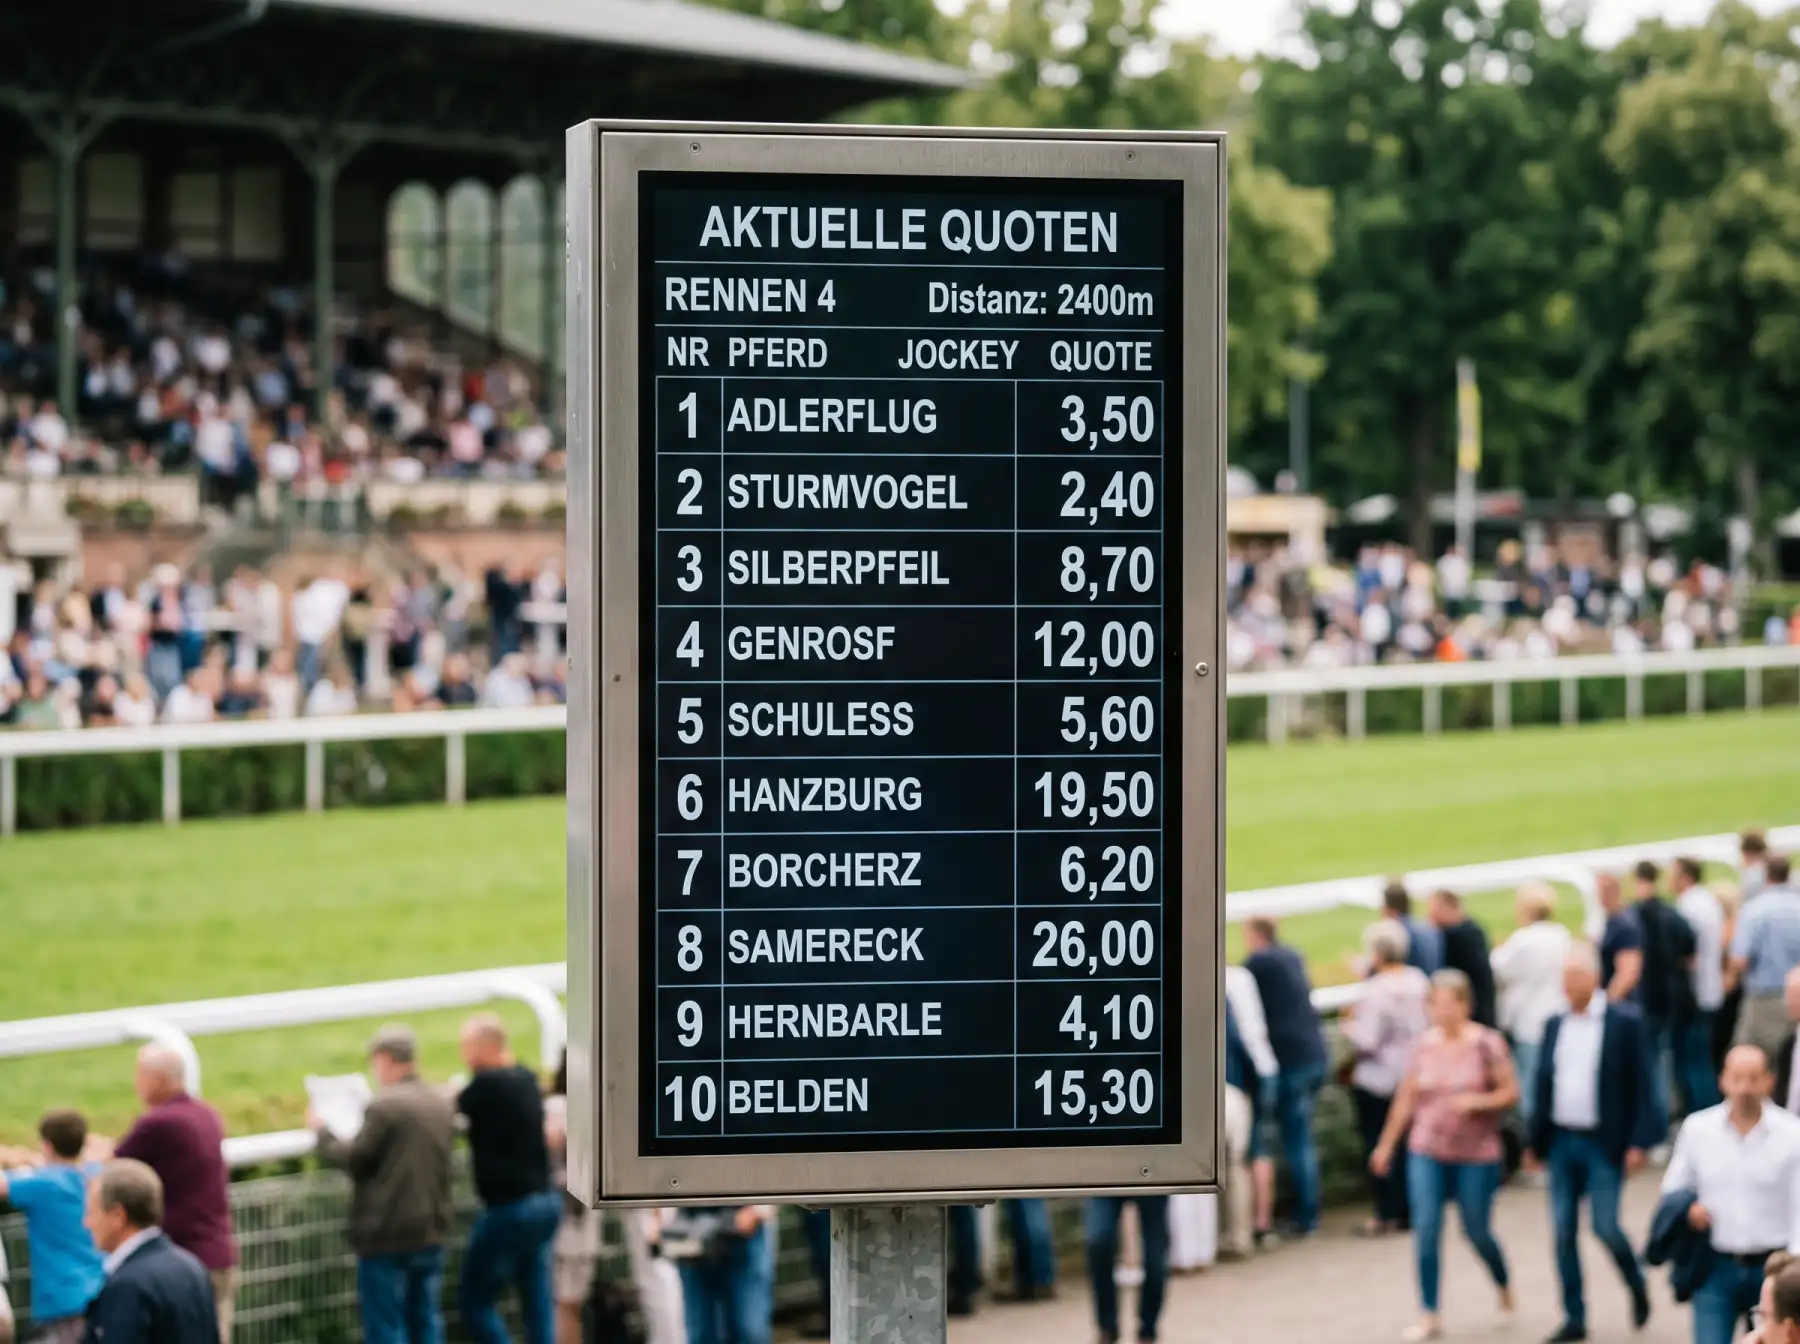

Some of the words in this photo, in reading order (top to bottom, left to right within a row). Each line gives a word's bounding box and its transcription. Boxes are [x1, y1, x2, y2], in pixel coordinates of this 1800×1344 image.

[700, 206, 926, 249] AKTUELLE
[941, 209, 1117, 253] QUOTEN
[666, 277, 806, 312] RENNEN
[818, 279, 836, 312] 4
[929, 281, 1047, 314] Distanz:
[1058, 284, 1153, 315] 2400m
[667, 337, 709, 366] NR
[729, 338, 827, 367] PFERD
[898, 339, 1019, 370] JOCKEY
[1050, 341, 1152, 372] QUOTE
[679, 393, 697, 438] 1
[727, 398, 937, 433] ADLERFLUG
[1061, 395, 1154, 450] 3,50
[677, 469, 702, 514] 2
[728, 474, 968, 509] STURMVOGEL
[1060, 471, 1154, 525] 2,40
[677, 545, 703, 591] 3
[728, 550, 949, 584] SILBERPFEIL
[1061, 546, 1154, 601] 8,70
[676, 621, 703, 667] 4
[728, 626, 895, 660] GENROSF
[1034, 621, 1154, 675] 12,00
[677, 698, 703, 744] 5
[728, 702, 914, 736] SCHULESS
[1061, 696, 1154, 750] 5,60
[677, 774, 703, 820] 6
[728, 777, 922, 812] HANZBURG
[1034, 771, 1154, 825] 19,50
[677, 850, 703, 896] 7
[729, 853, 922, 888] BORCHERZ
[1060, 846, 1154, 900] 6,20
[677, 925, 703, 971] 8
[728, 928, 924, 963] SAMERECK
[1033, 920, 1154, 975] 26,00
[677, 1001, 703, 1047] 9
[729, 1002, 942, 1038] HERNBARLE
[1060, 995, 1154, 1049] 4,10
[665, 1076, 717, 1122] 10
[729, 1078, 868, 1113] BELDEN
[1034, 1069, 1154, 1123] 15,30
